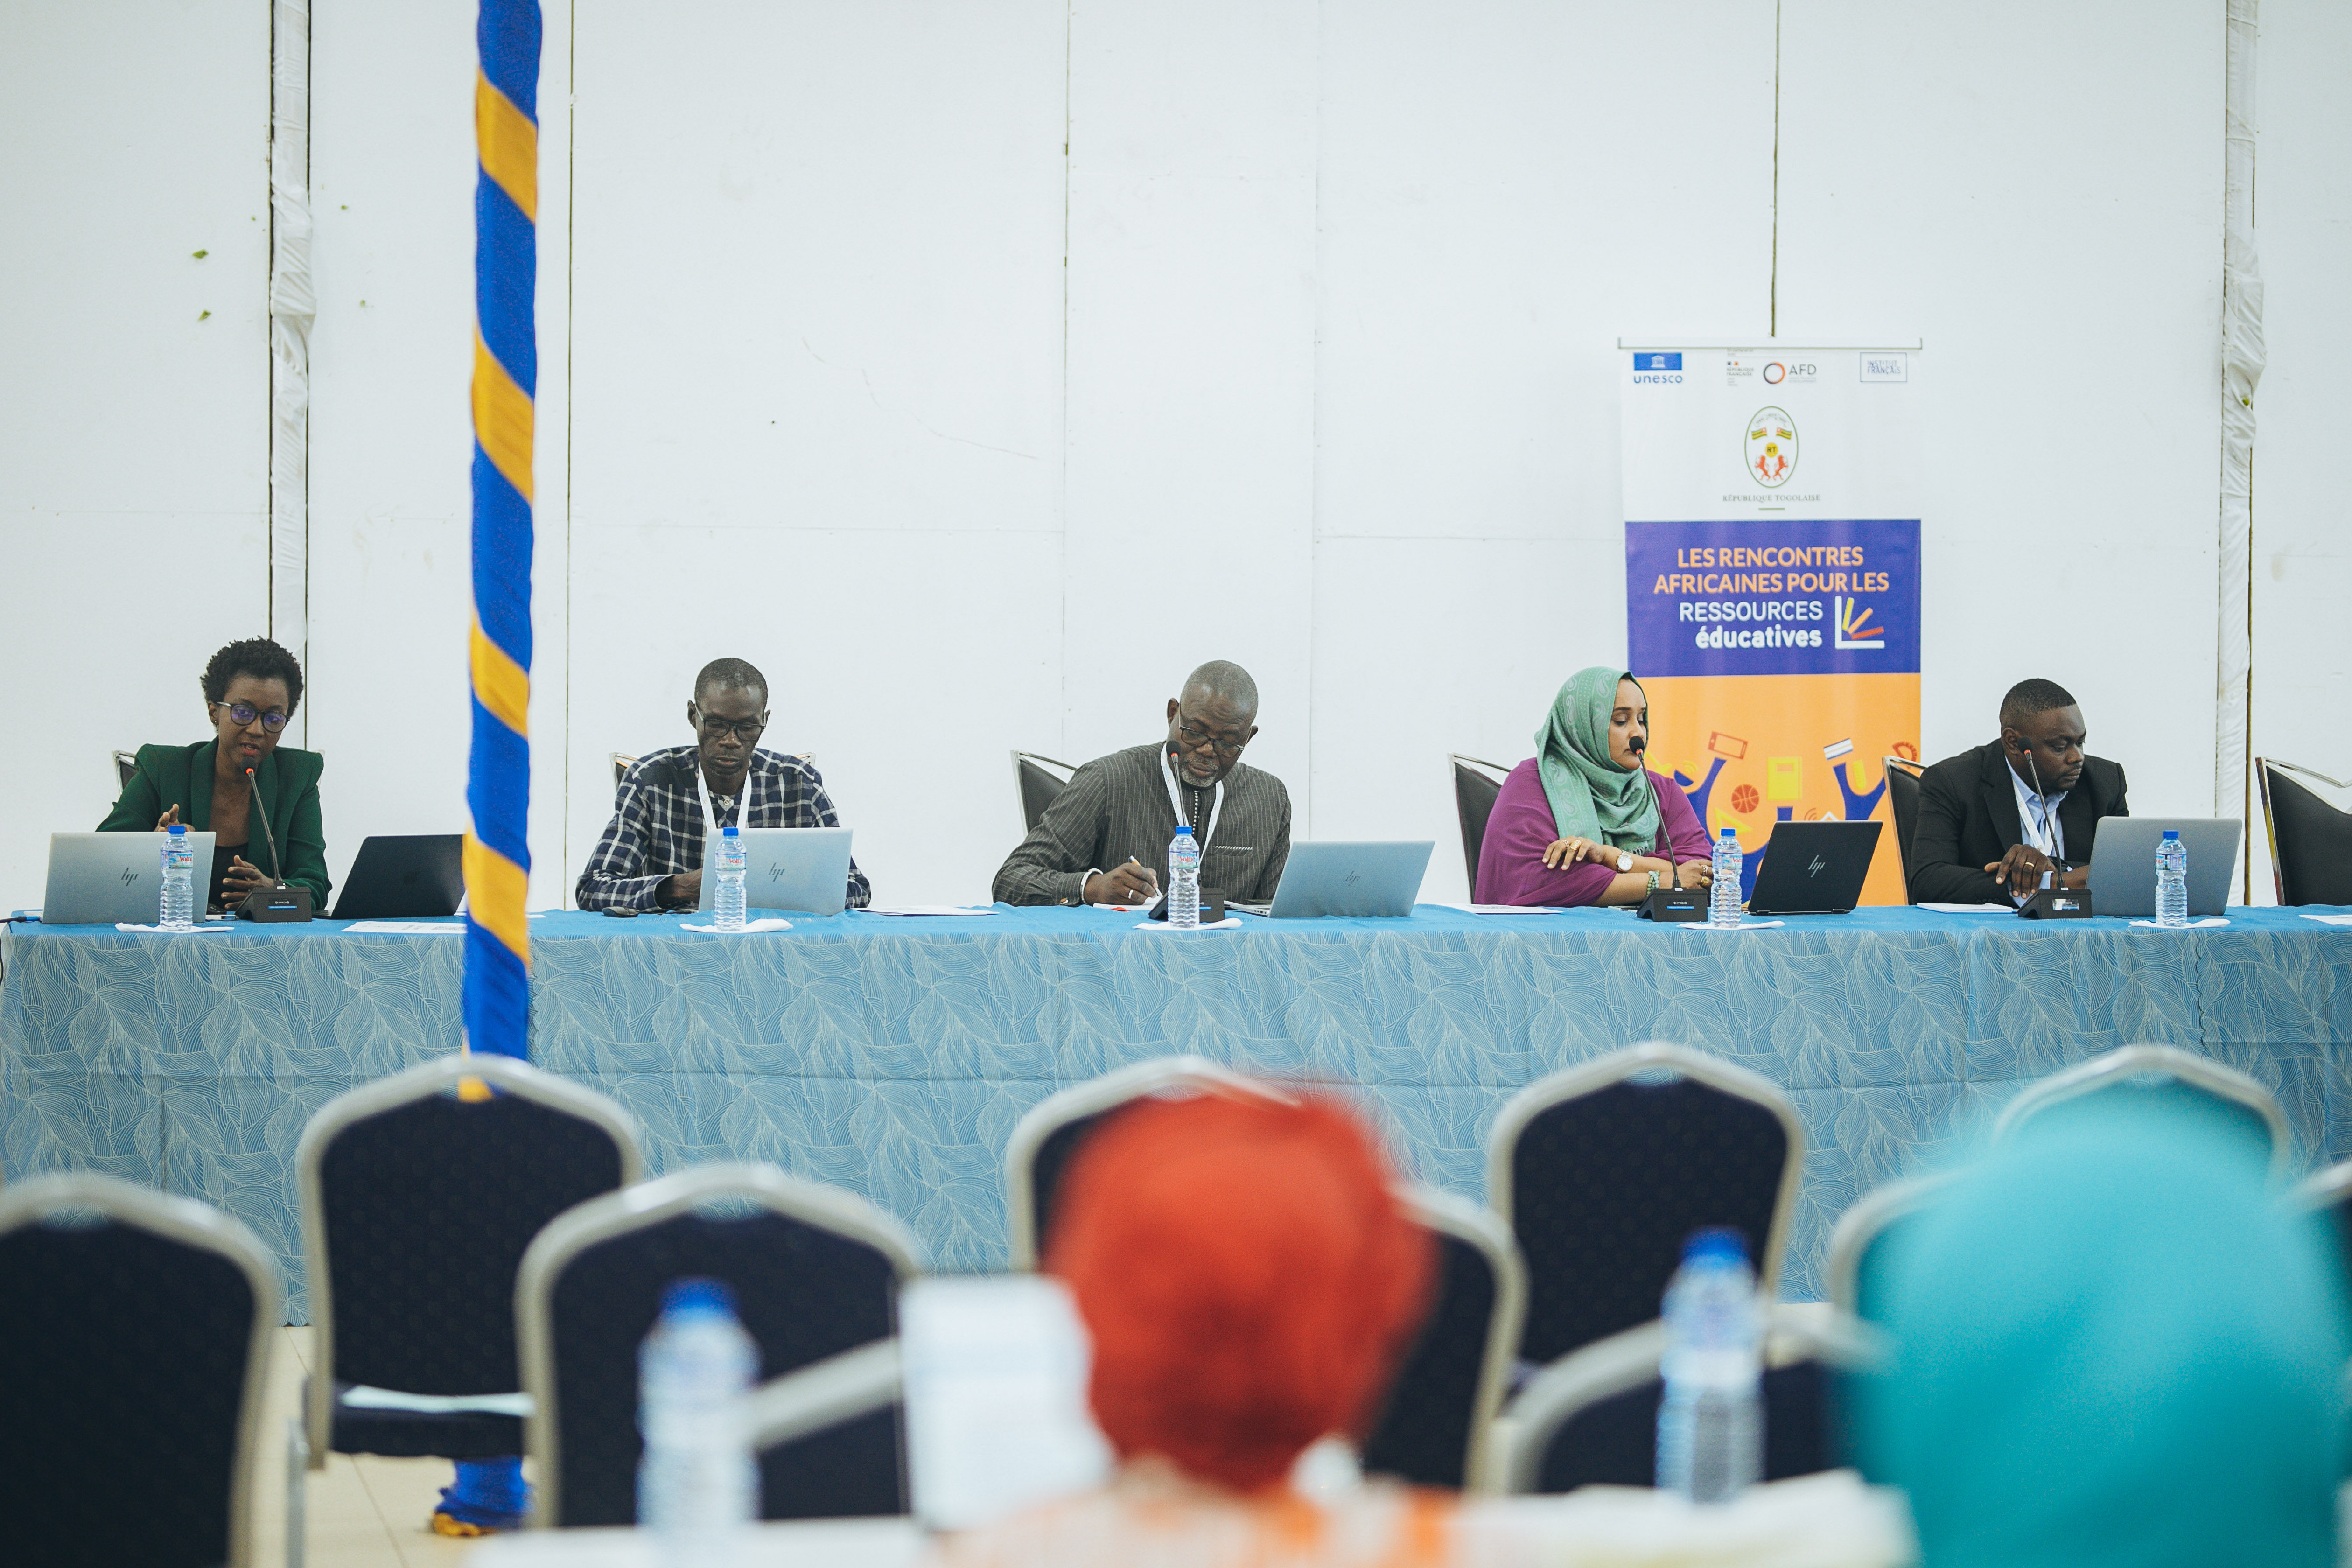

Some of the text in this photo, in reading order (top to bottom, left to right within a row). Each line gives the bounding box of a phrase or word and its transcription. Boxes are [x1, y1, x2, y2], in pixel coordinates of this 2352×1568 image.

[1789, 364, 1816, 375] AFD
[1867, 366, 1901, 375] FRANÇAIS
[1722, 494, 1772, 503] RÉPUBLIQUE
[1678, 547, 1864, 568] LES RENCONTRES
[1653, 572, 1890, 594] AFRICAINES POUR LES
[1680, 601, 1823, 622] RESSOURCES
[1695, 624, 1823, 649] éducatives
[1808, 854, 1826, 878] hp
